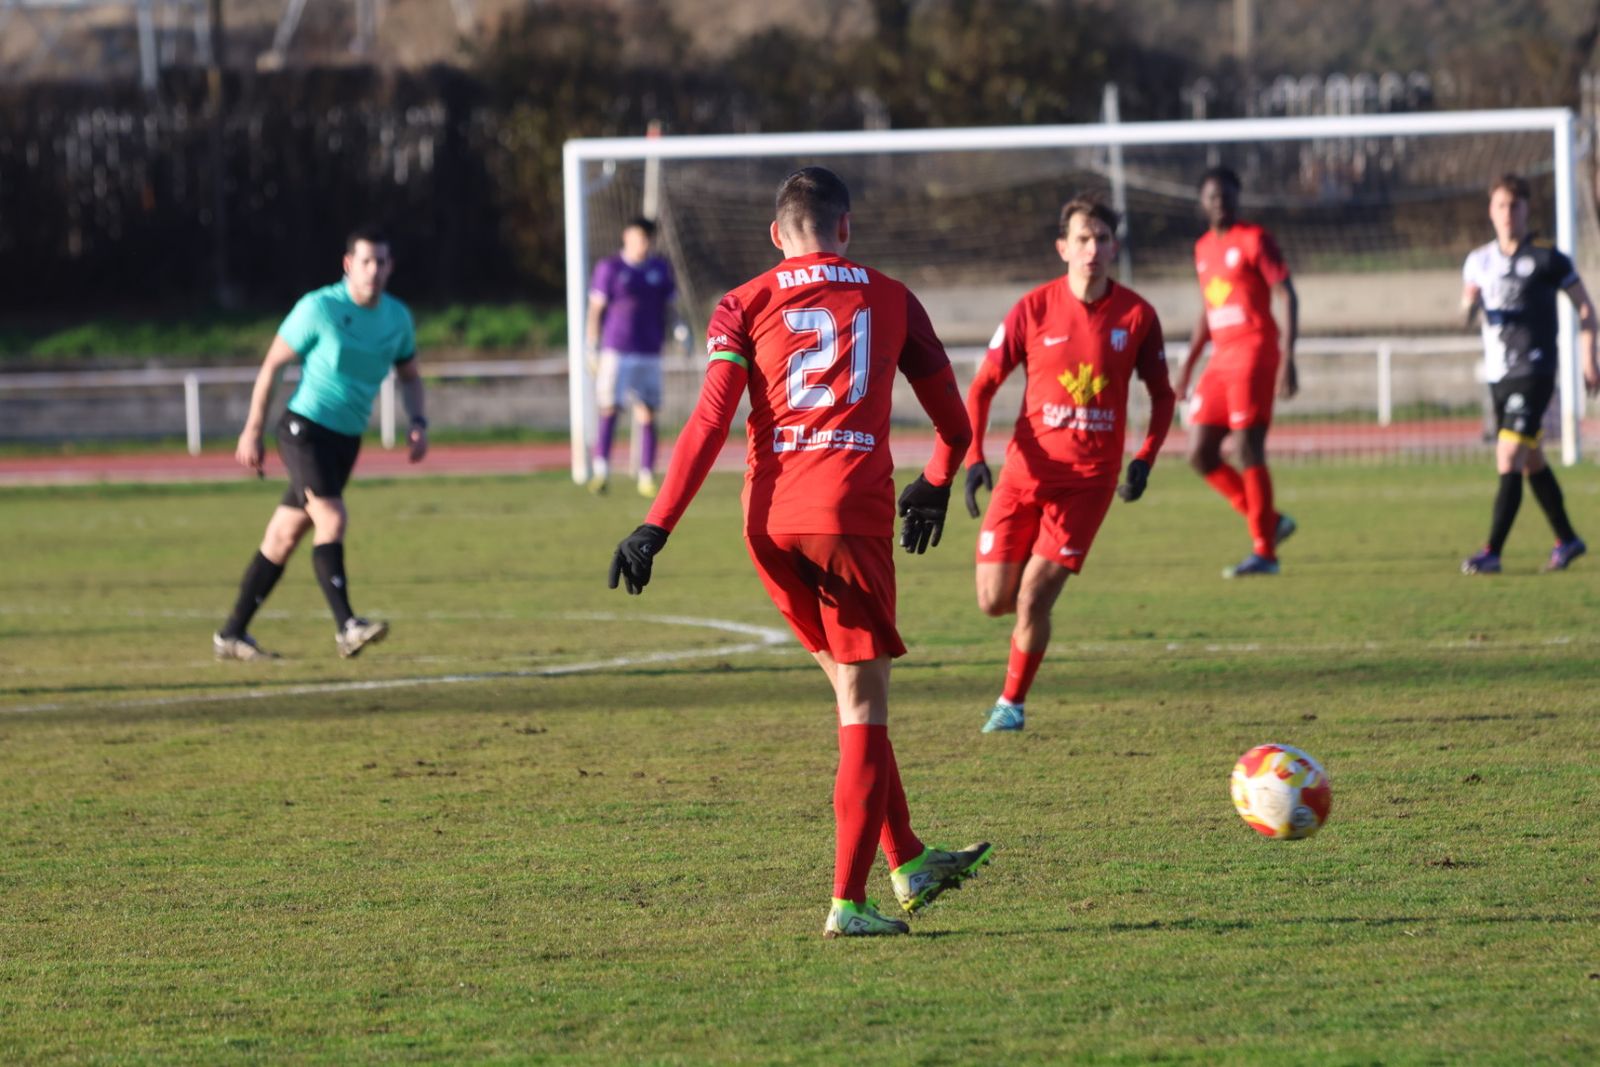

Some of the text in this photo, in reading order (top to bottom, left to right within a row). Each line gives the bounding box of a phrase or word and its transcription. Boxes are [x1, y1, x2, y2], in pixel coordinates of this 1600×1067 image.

[776, 264, 870, 289] RAZVAN
[782, 307, 871, 411] 21
[797, 424, 875, 445] Limcasa
